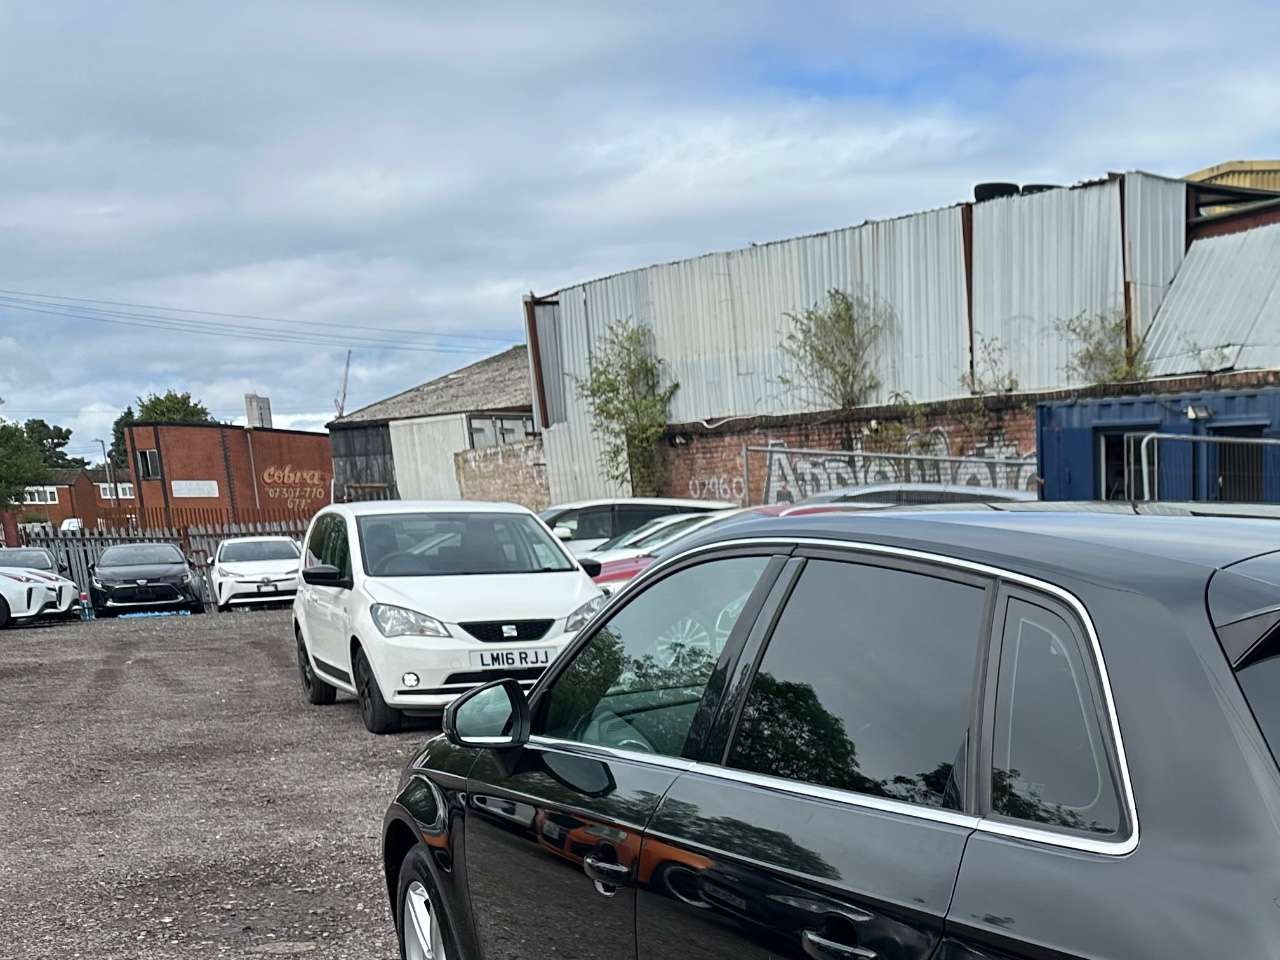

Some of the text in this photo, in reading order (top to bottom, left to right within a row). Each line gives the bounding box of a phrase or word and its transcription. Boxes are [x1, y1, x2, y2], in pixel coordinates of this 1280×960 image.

[262, 464, 323, 486] Cobra
[479, 650, 549, 667] LM16 RJJ
